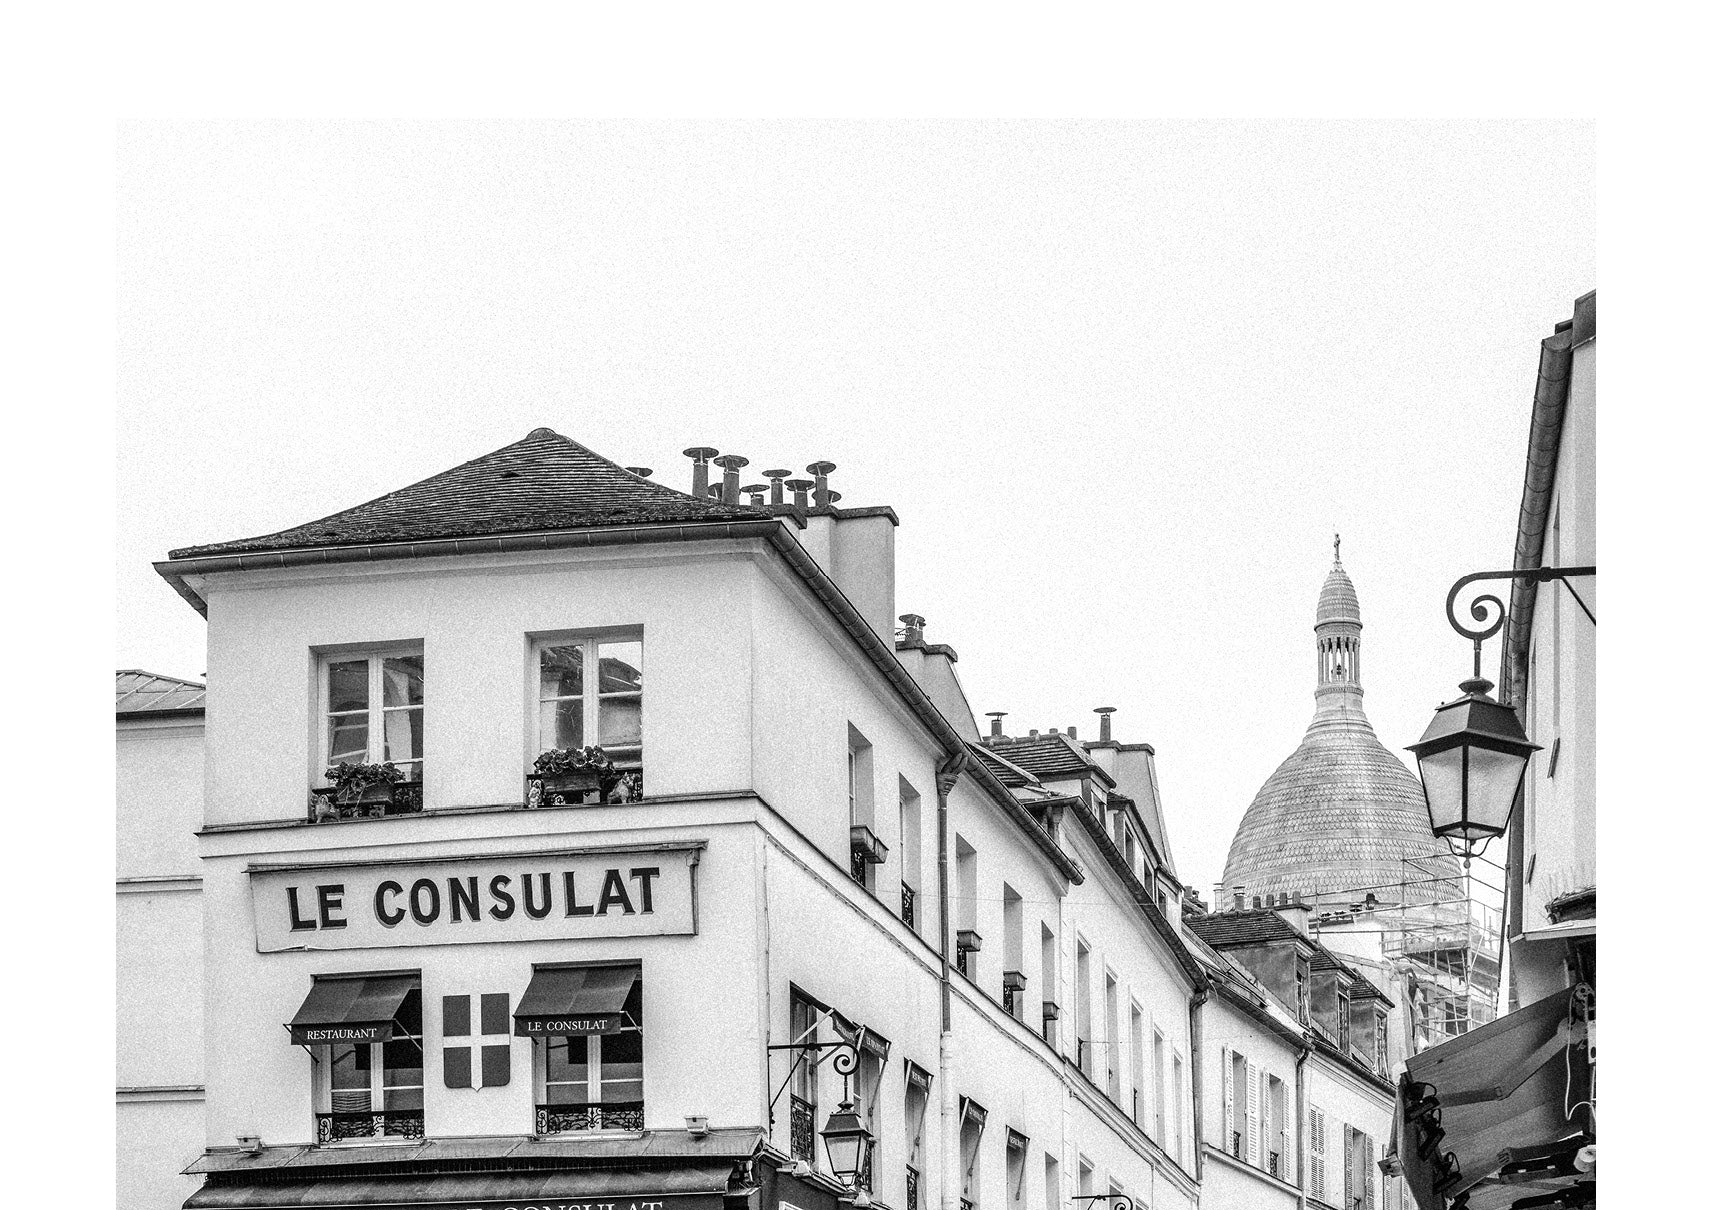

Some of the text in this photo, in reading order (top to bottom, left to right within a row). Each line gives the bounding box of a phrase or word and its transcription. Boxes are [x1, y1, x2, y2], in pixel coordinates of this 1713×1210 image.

[286, 867, 660, 932] LE CONSULAT
[528, 1019, 608, 1032] LE CONSULAT
[307, 1028, 377, 1041] RESTAURANT
